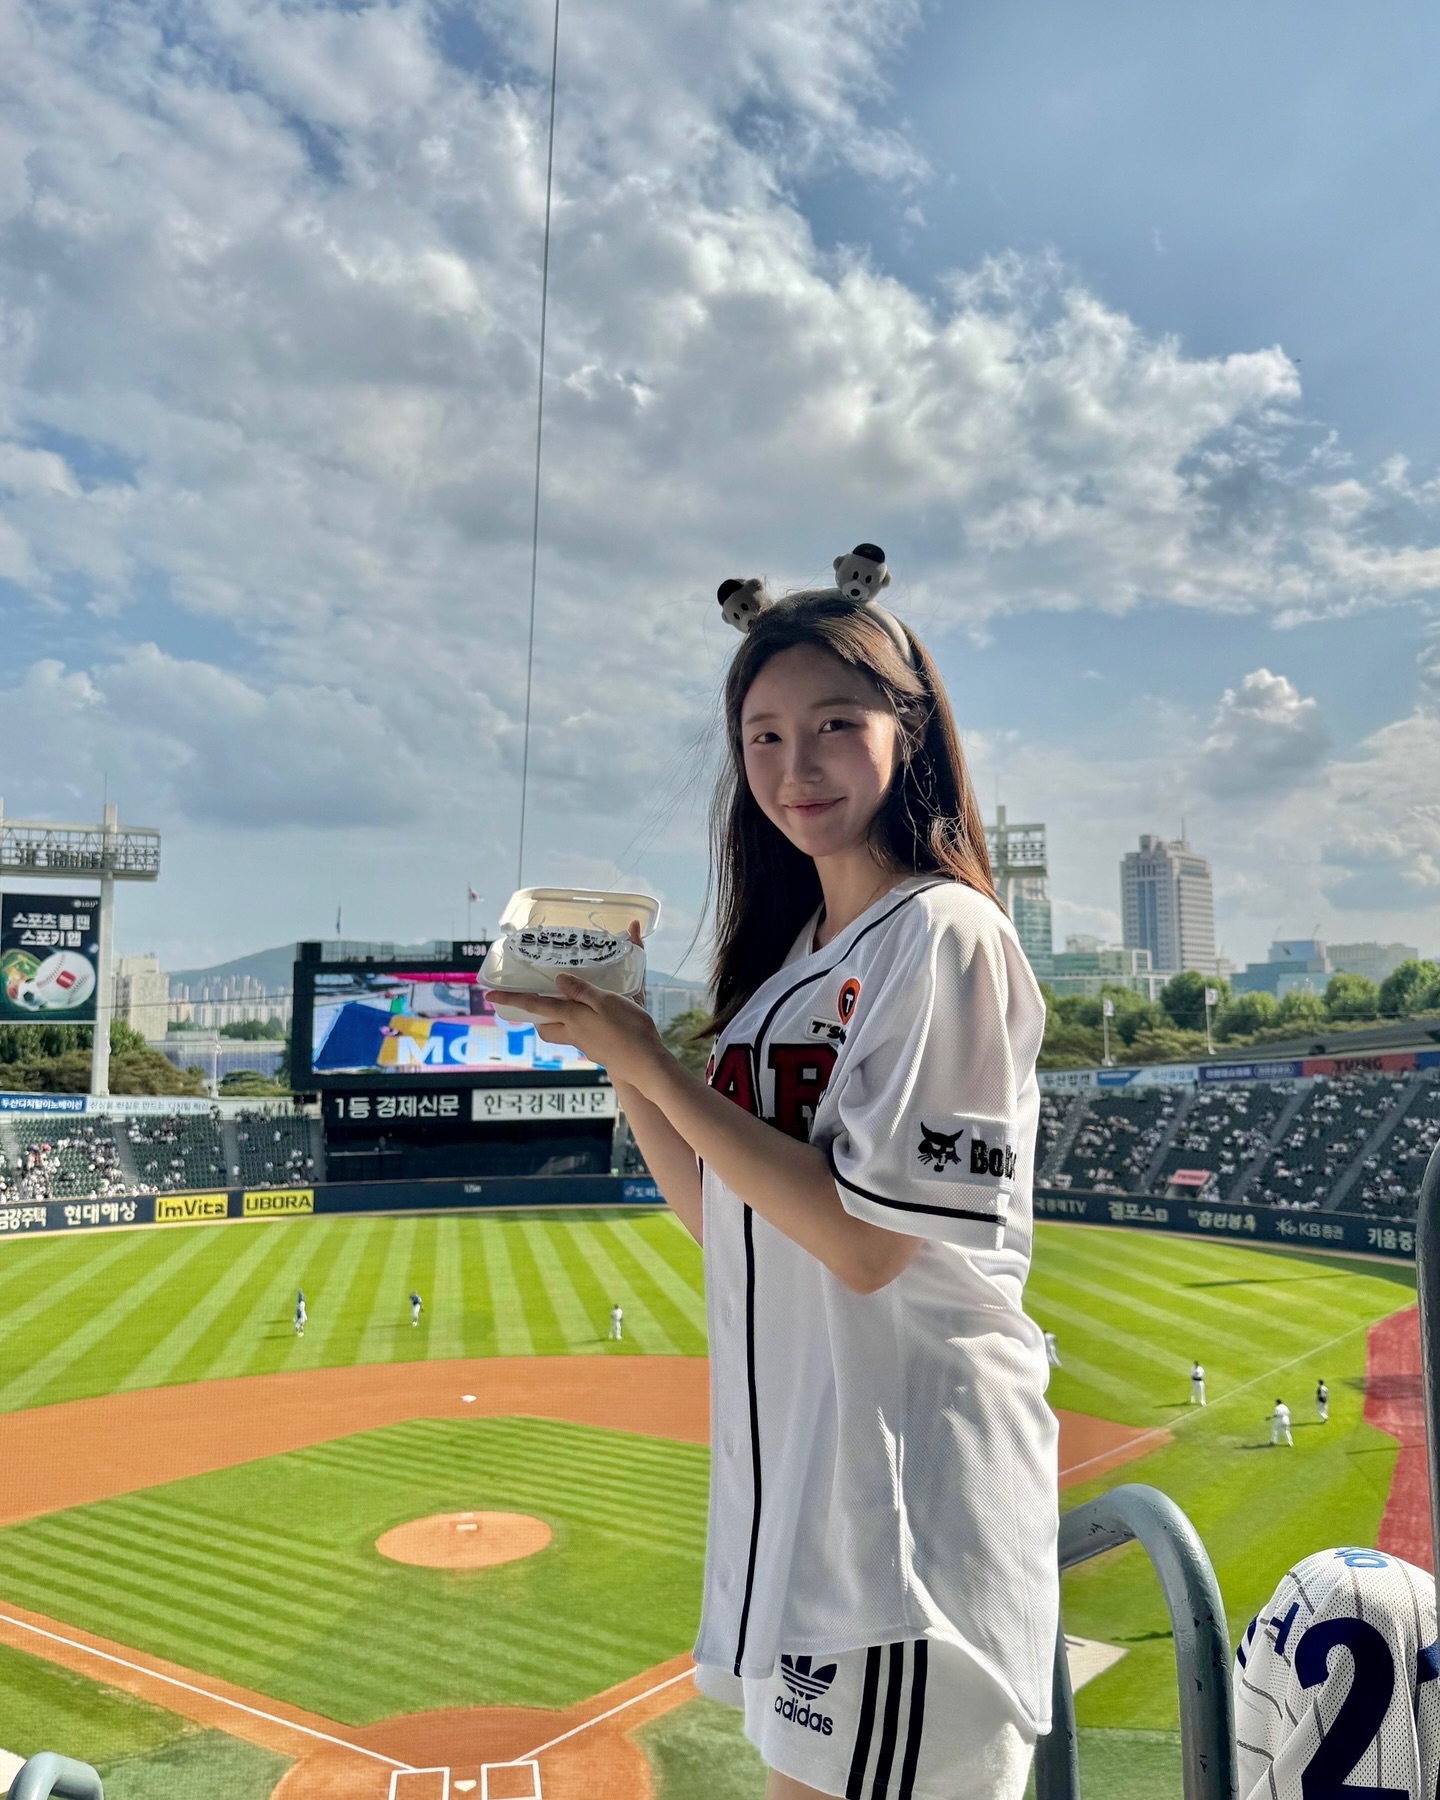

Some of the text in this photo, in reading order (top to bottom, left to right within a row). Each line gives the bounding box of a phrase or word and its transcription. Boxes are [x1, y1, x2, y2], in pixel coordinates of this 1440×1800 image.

[12, 911, 57, 929] 스포츠
[59, 914, 74, 931] 볼
[20, 930, 82, 947] 스포키 앱
[1, 1096, 83, 1111] 두산디지털이노베이션
[334, 1094, 460, 1119] 1등 경제신문
[483, 1091, 608, 1116] 한국경제신문
[63, 1201, 138, 1227] 현대해상
[245, 1194, 313, 1212] UBORA
[0, 1206, 47, 1231] 금강주택
[1299, 1222, 1344, 1241] KB증권
[1367, 1227, 1416, 1252] 키움증
[774, 1695, 834, 1736] adidas
[1294, 1616, 1410, 1800] 2
